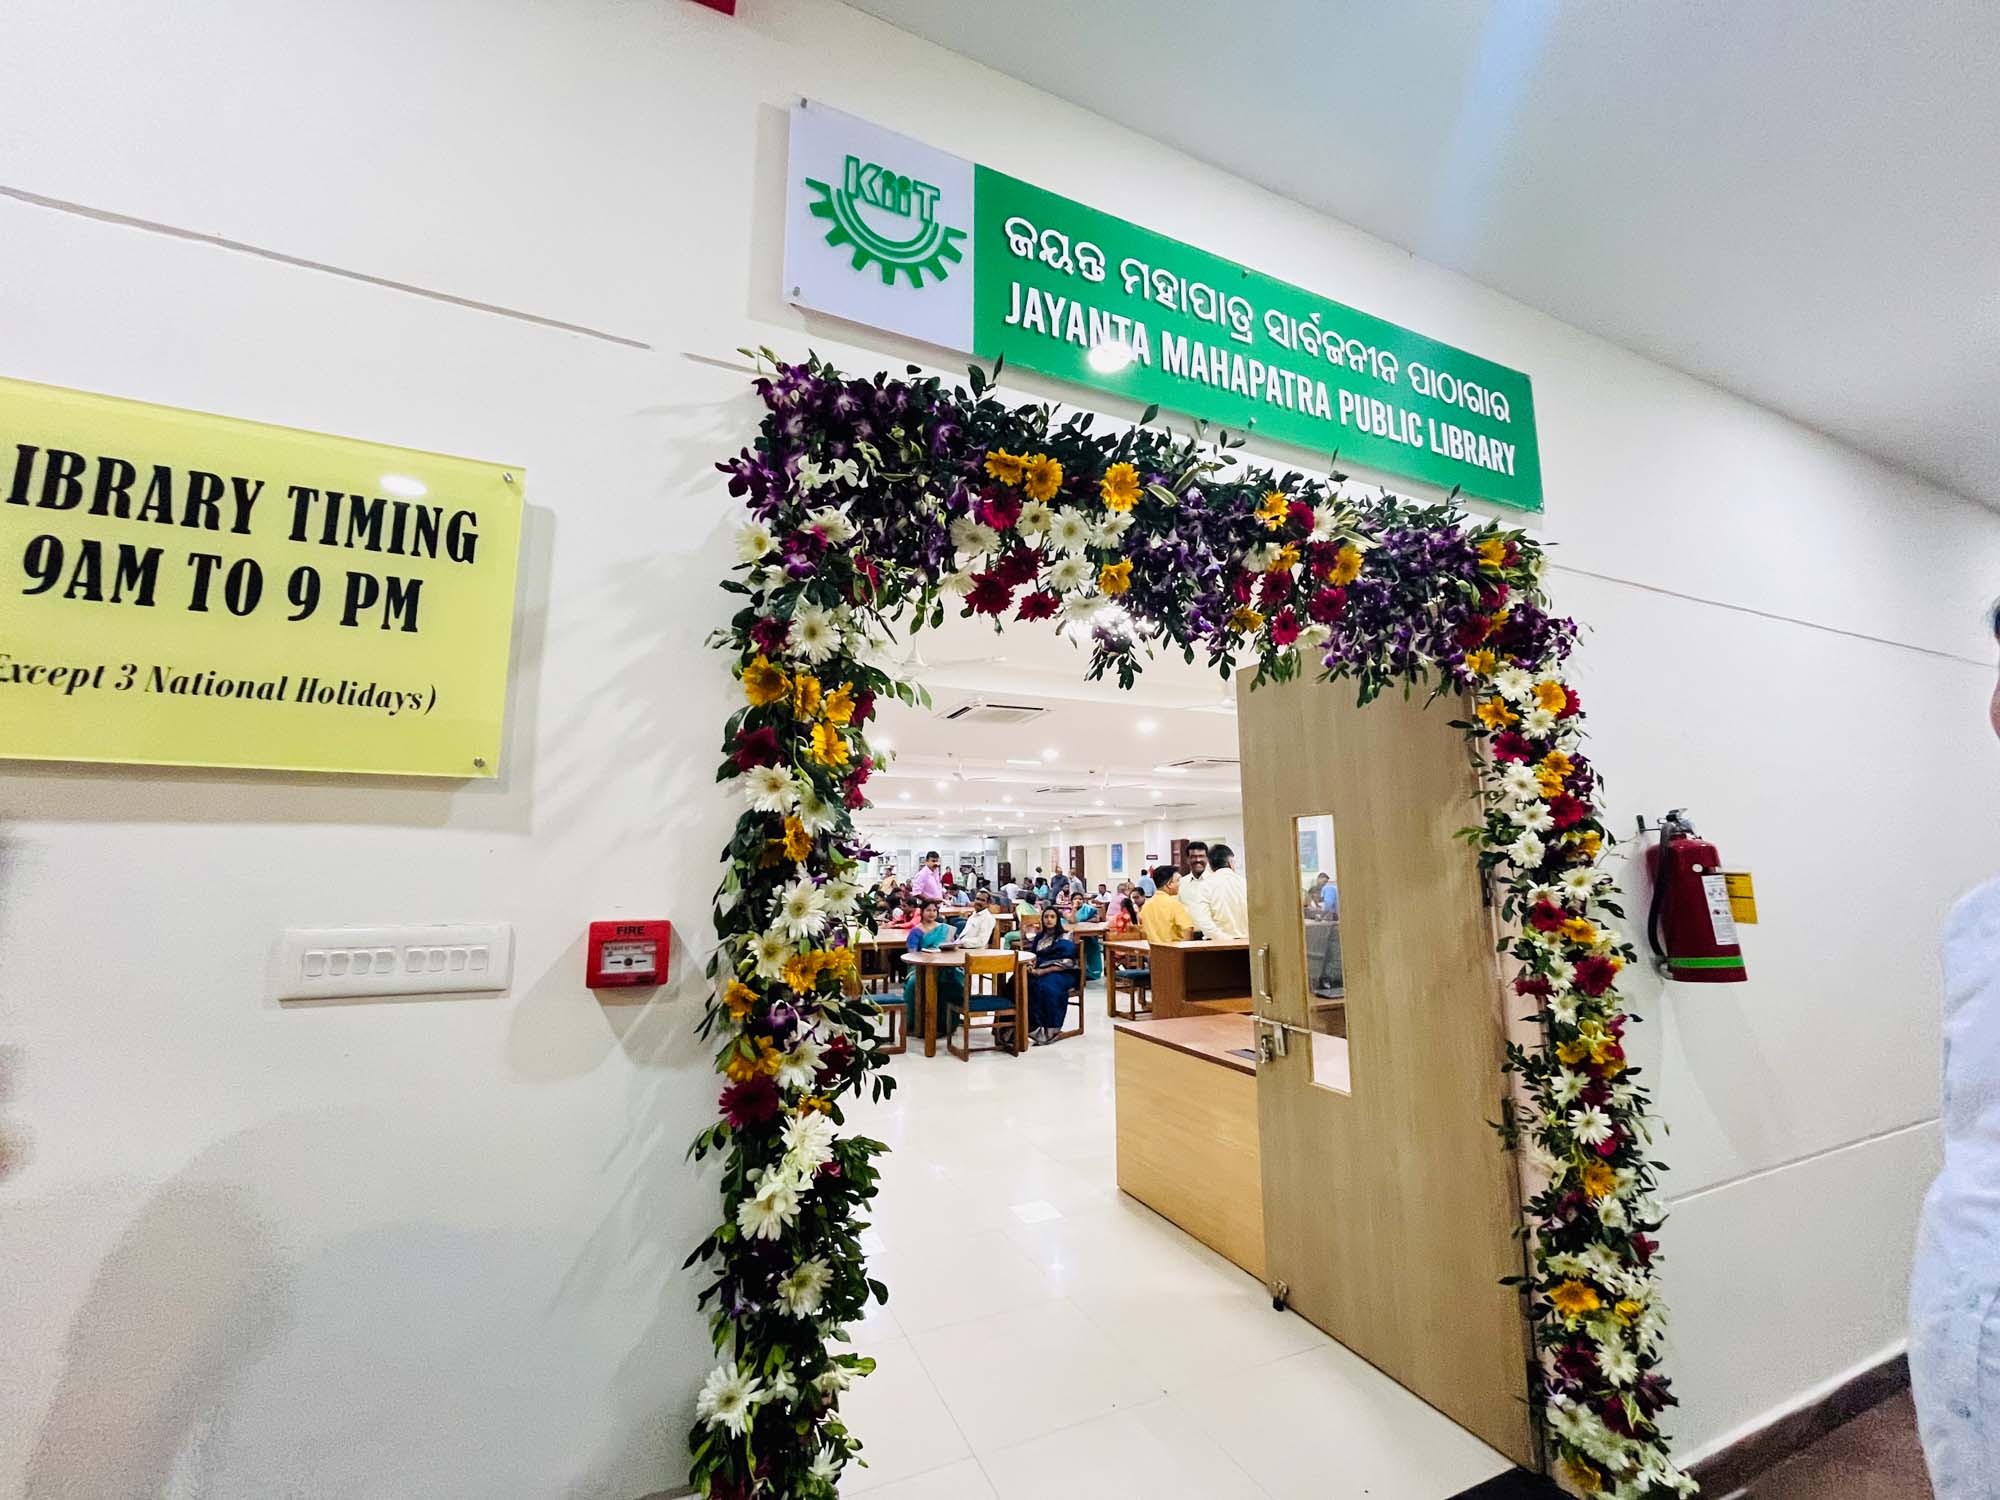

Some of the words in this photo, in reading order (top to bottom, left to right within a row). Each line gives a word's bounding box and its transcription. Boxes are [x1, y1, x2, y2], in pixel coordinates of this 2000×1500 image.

[1004, 216, 1106, 282] ଜୟନ୍ତ
[1120, 258, 1253, 344] ମହାପାତ୍ର
[1263, 309, 1399, 384] ସାର୍ବଜନୀନ
[1407, 361, 1511, 423] ପାଠାଗାର
[1005, 281, 1151, 365] JAYANTA
[1161, 330, 1332, 421] MAHAPATRA
[1338, 388, 1423, 448] PUBLIC
[1428, 418, 1515, 476] LIBRARY
[0, 444, 264, 535] IBRARY
[287, 485, 479, 564] TIMING
[22, 534, 165, 607] 9AM
[187, 552, 264, 617] TO
[286, 565, 321, 622] 9
[339, 571, 424, 633] PM
[114, 663, 138, 691] 3
[145, 665, 288, 702] National
[295, 676, 437, 716] Holidays)
[616, 926, 645, 935] FIRE
